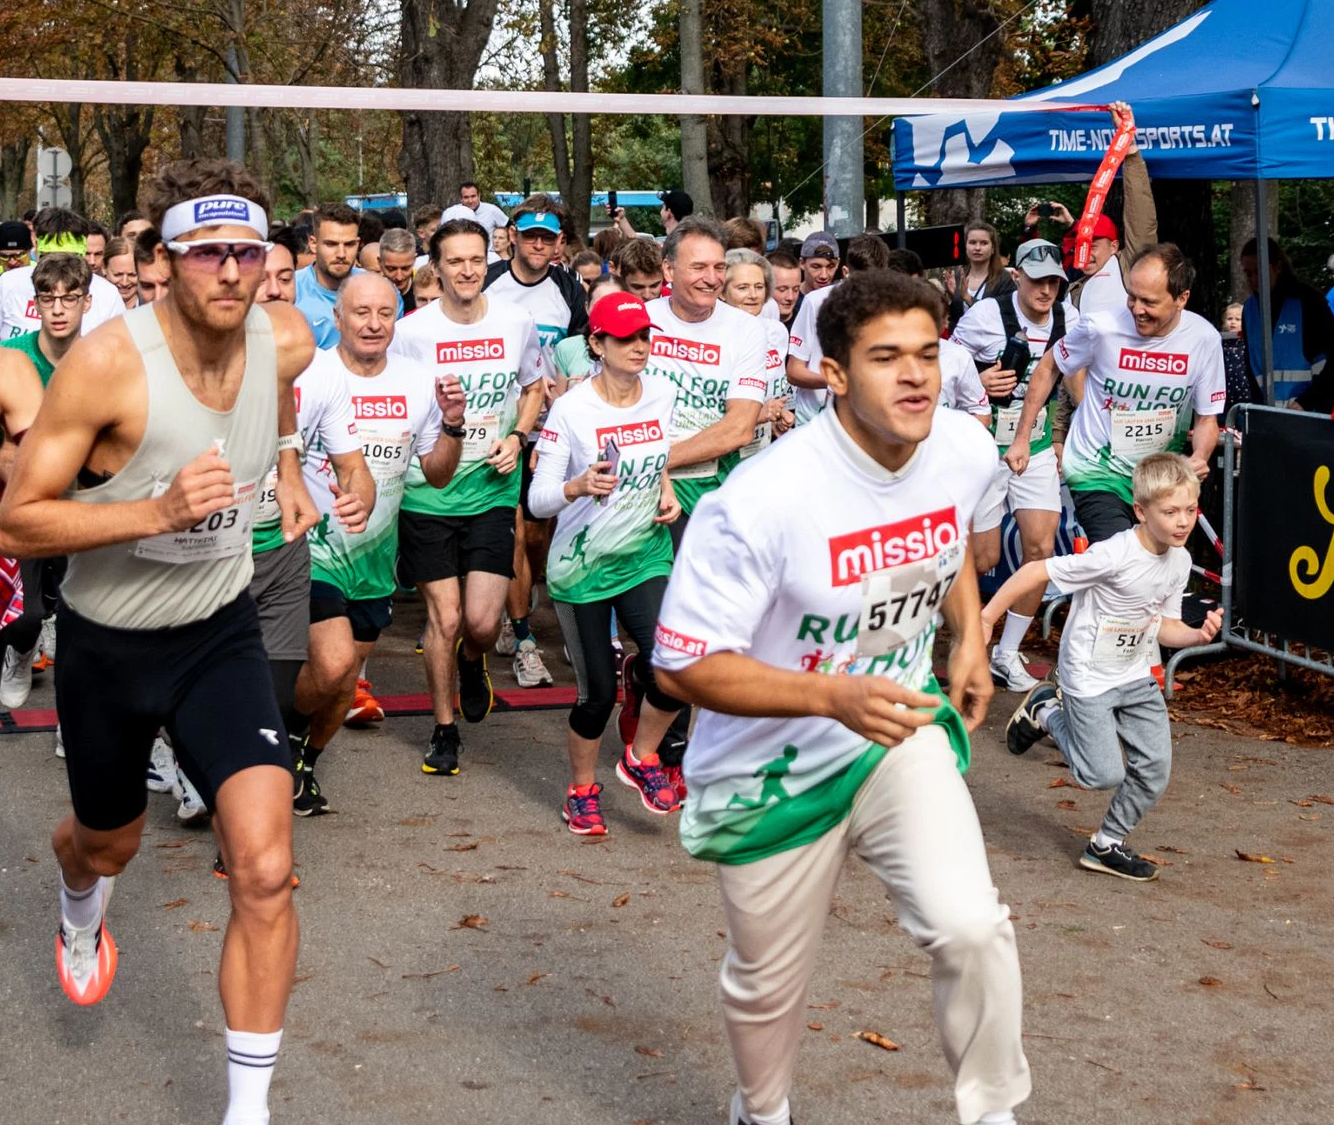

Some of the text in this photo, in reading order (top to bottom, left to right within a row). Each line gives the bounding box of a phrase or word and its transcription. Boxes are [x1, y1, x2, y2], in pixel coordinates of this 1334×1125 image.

[198, 200, 246, 215] pure
[439, 340, 503, 361] missio
[653, 339, 719, 364] missio
[1121, 352, 1187, 374] missio
[691, 377, 730, 397] FOR
[1103, 377, 1151, 400] RUN
[353, 397, 405, 417] issio
[465, 391, 505, 410] HOP
[598, 423, 661, 448] missio
[1125, 423, 1163, 437] 2215
[362, 444, 403, 460] 1065
[836, 517, 958, 581] missio
[796, 613, 860, 644] RU
